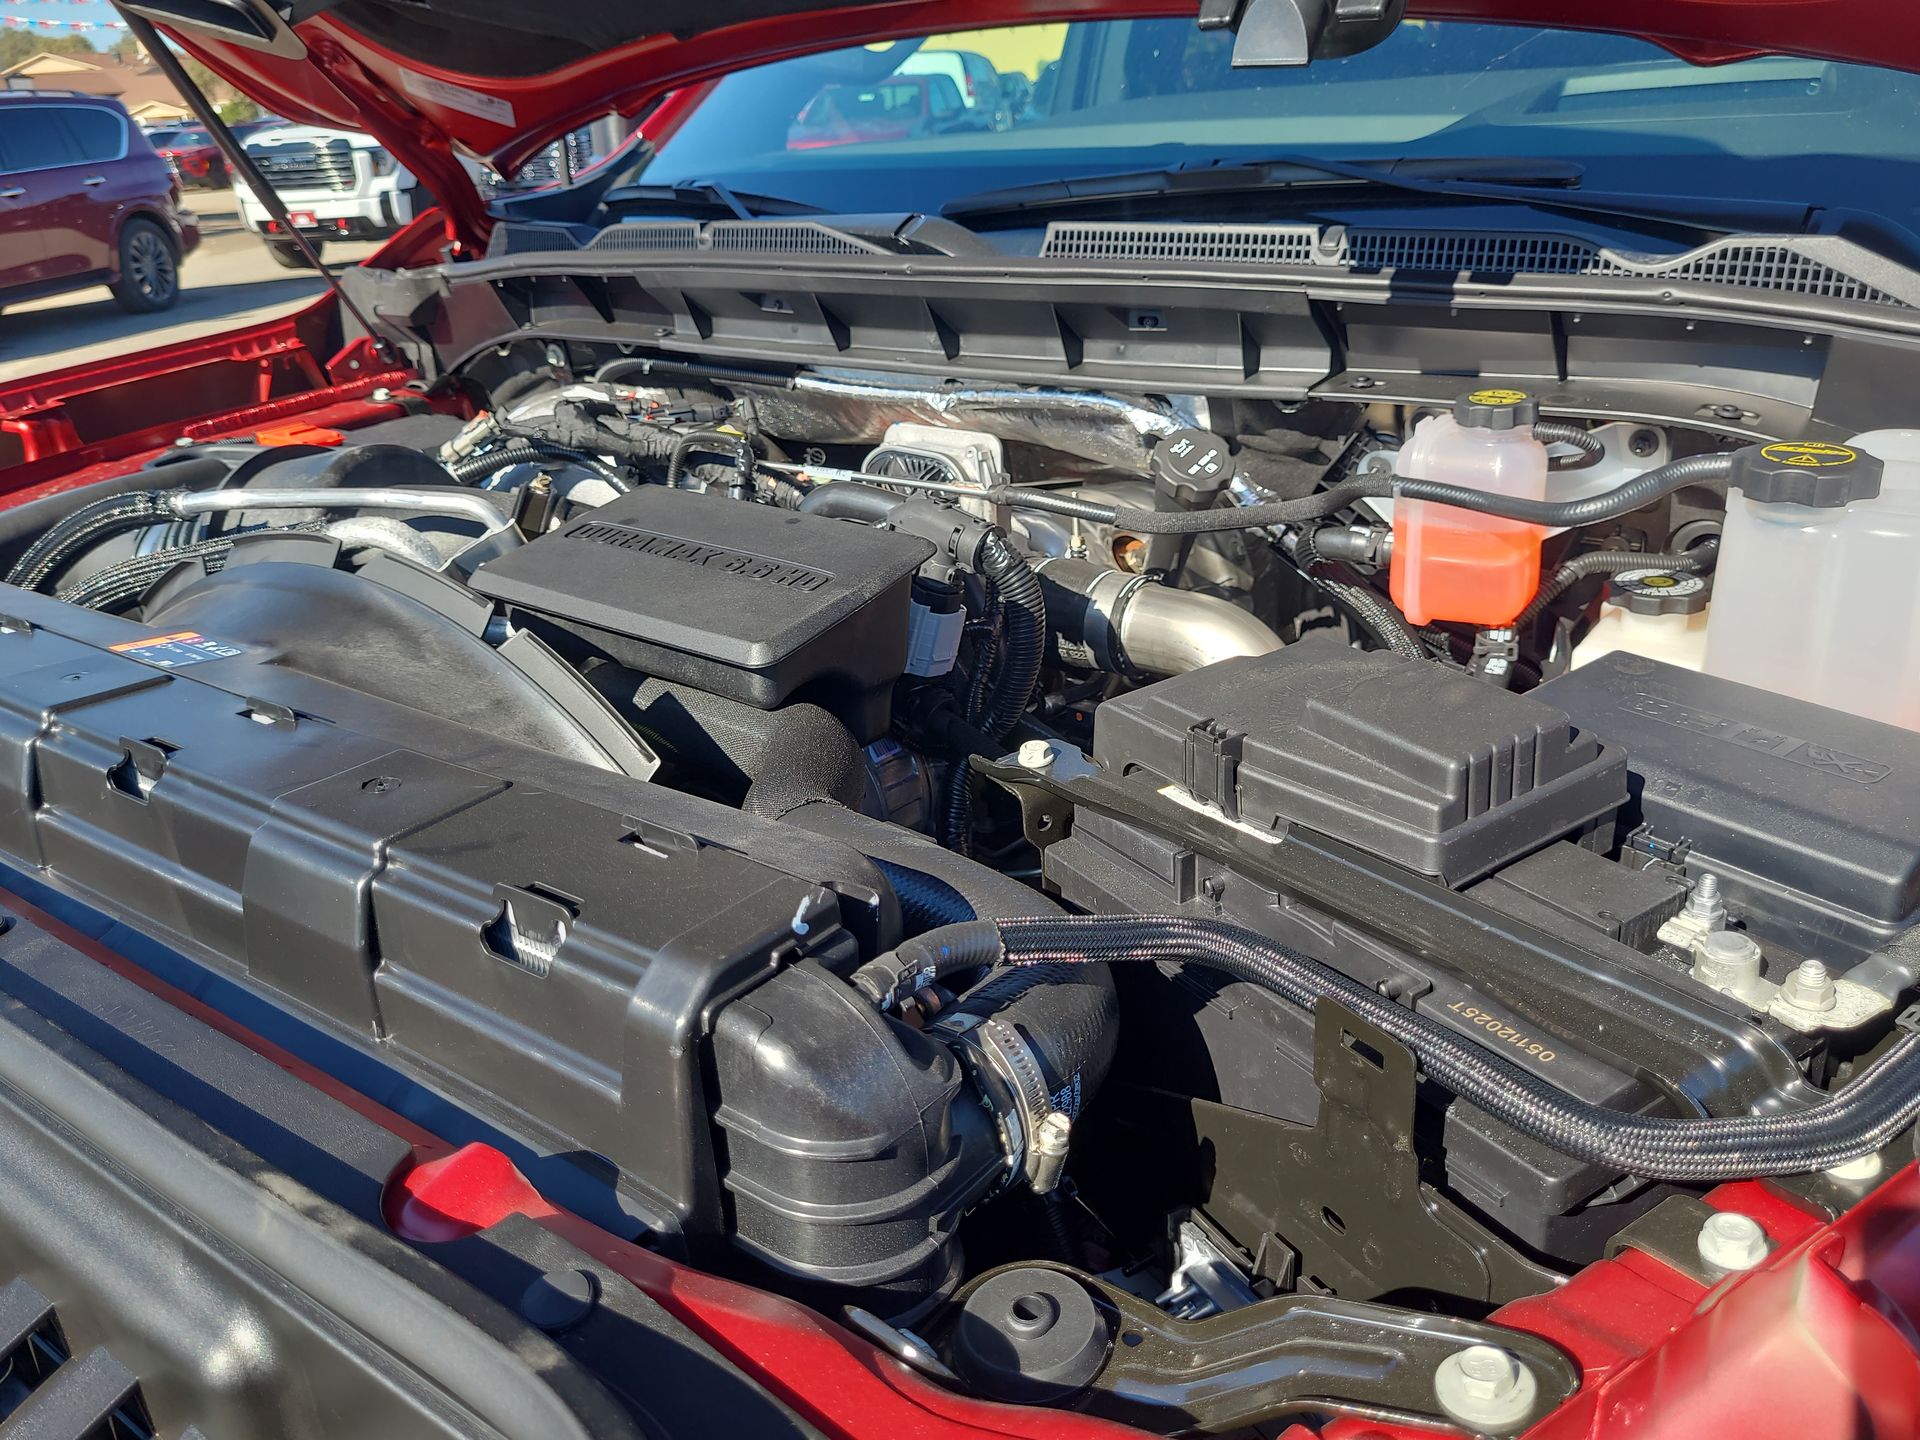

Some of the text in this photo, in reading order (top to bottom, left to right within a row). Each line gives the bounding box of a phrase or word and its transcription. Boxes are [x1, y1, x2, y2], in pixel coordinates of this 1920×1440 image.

[565, 523, 830, 592] DURAMAX 6.6 HD
[1446, 1001, 1556, 1062] 05112025T
